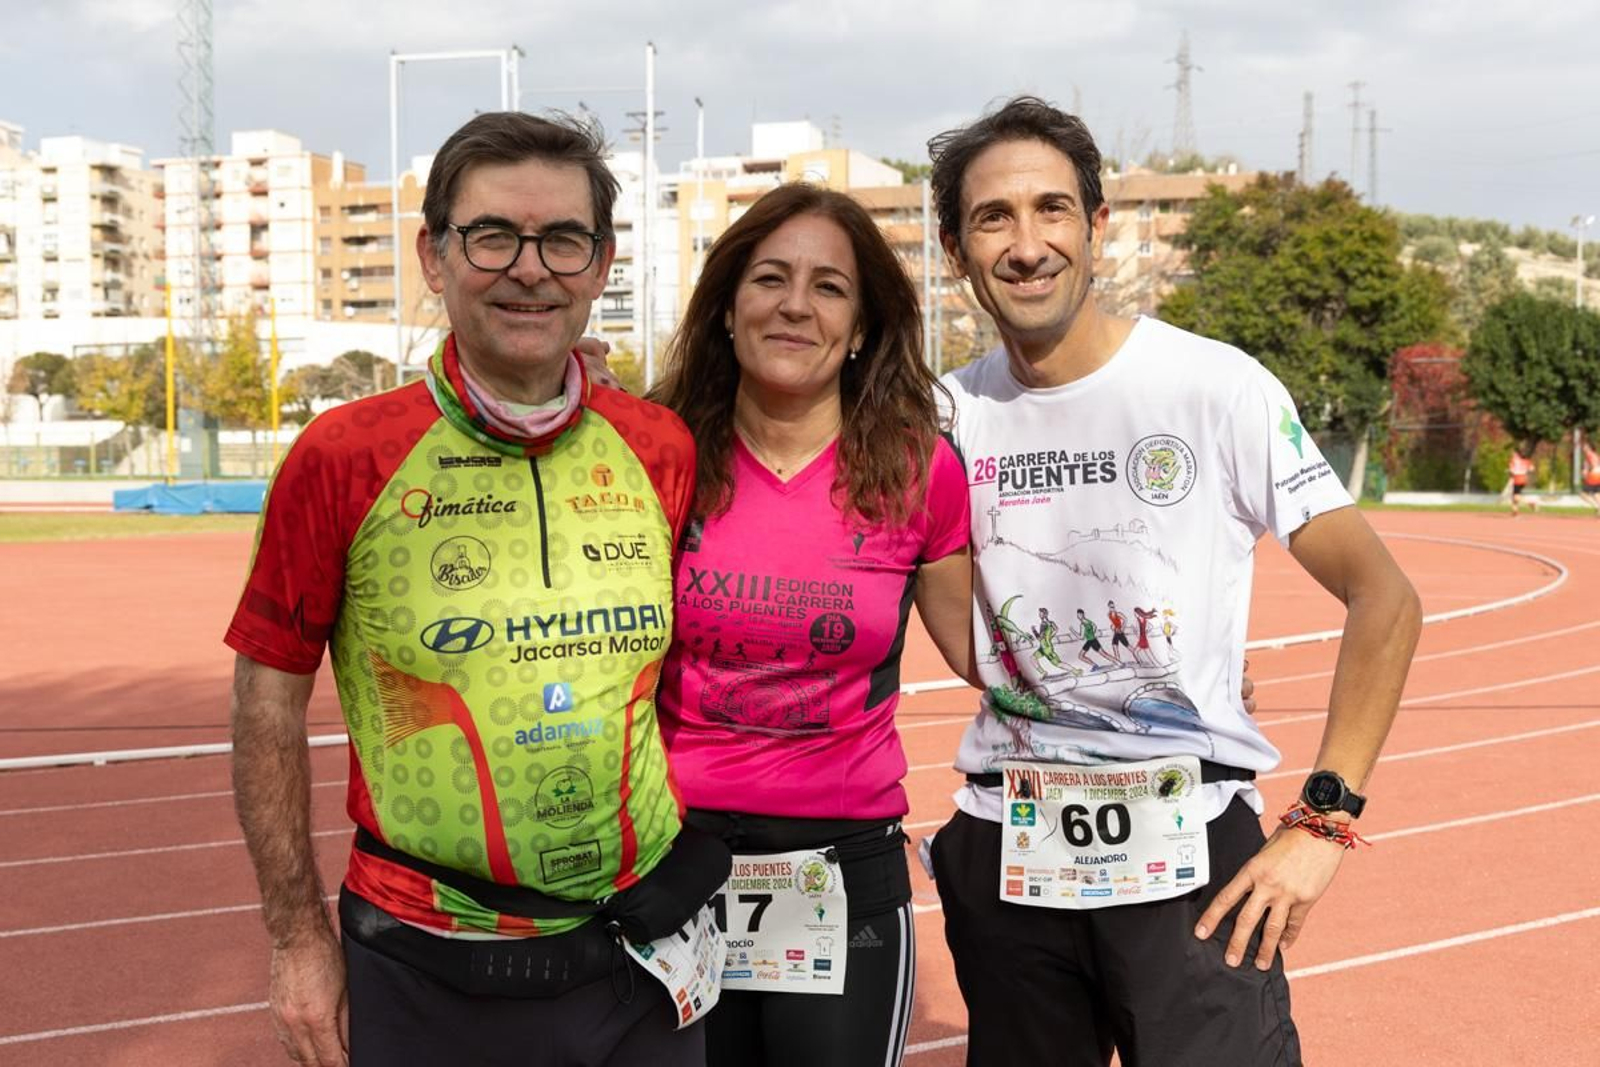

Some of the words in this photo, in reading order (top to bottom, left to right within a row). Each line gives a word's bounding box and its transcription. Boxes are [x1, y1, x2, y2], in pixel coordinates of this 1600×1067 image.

[974, 456, 997, 482] 26
[999, 450, 1069, 470] CARRERA
[1073, 452, 1089, 462] DE
[1091, 450, 1116, 462] LOS
[998, 461, 1117, 491] PUENTES
[603, 542, 650, 560] DUE
[685, 567, 771, 602] XXIII
[776, 578, 853, 597] EDICIÓN
[680, 594, 688, 606] A
[692, 597, 724, 611] LOS
[729, 601, 807, 620] PUENTES
[774, 592, 854, 611] CARRERA
[506, 604, 666, 642] HYUNDAI
[821, 620, 846, 640] 19
[510, 640, 602, 664] Jacarsa
[609, 635, 666, 654] Motor
[1043, 770, 1081, 787] CARRERA
[1082, 773, 1090, 787] A
[1090, 773, 1107, 787] LOS
[1107, 770, 1148, 787] PUENTES
[1083, 788, 1088, 801] 1
[1088, 787, 1128, 801] DICIEMBRE
[1129, 785, 1149, 799] 2024
[537, 800, 594, 820] MOLIENDA
[1061, 803, 1131, 847] 60
[1073, 853, 1127, 865] ALEJANDRO
[734, 863, 751, 877] LOS
[752, 862, 793, 877] PUENTES
[731, 878, 771, 891] DICIEMBRE
[772, 878, 793, 889] 2024
